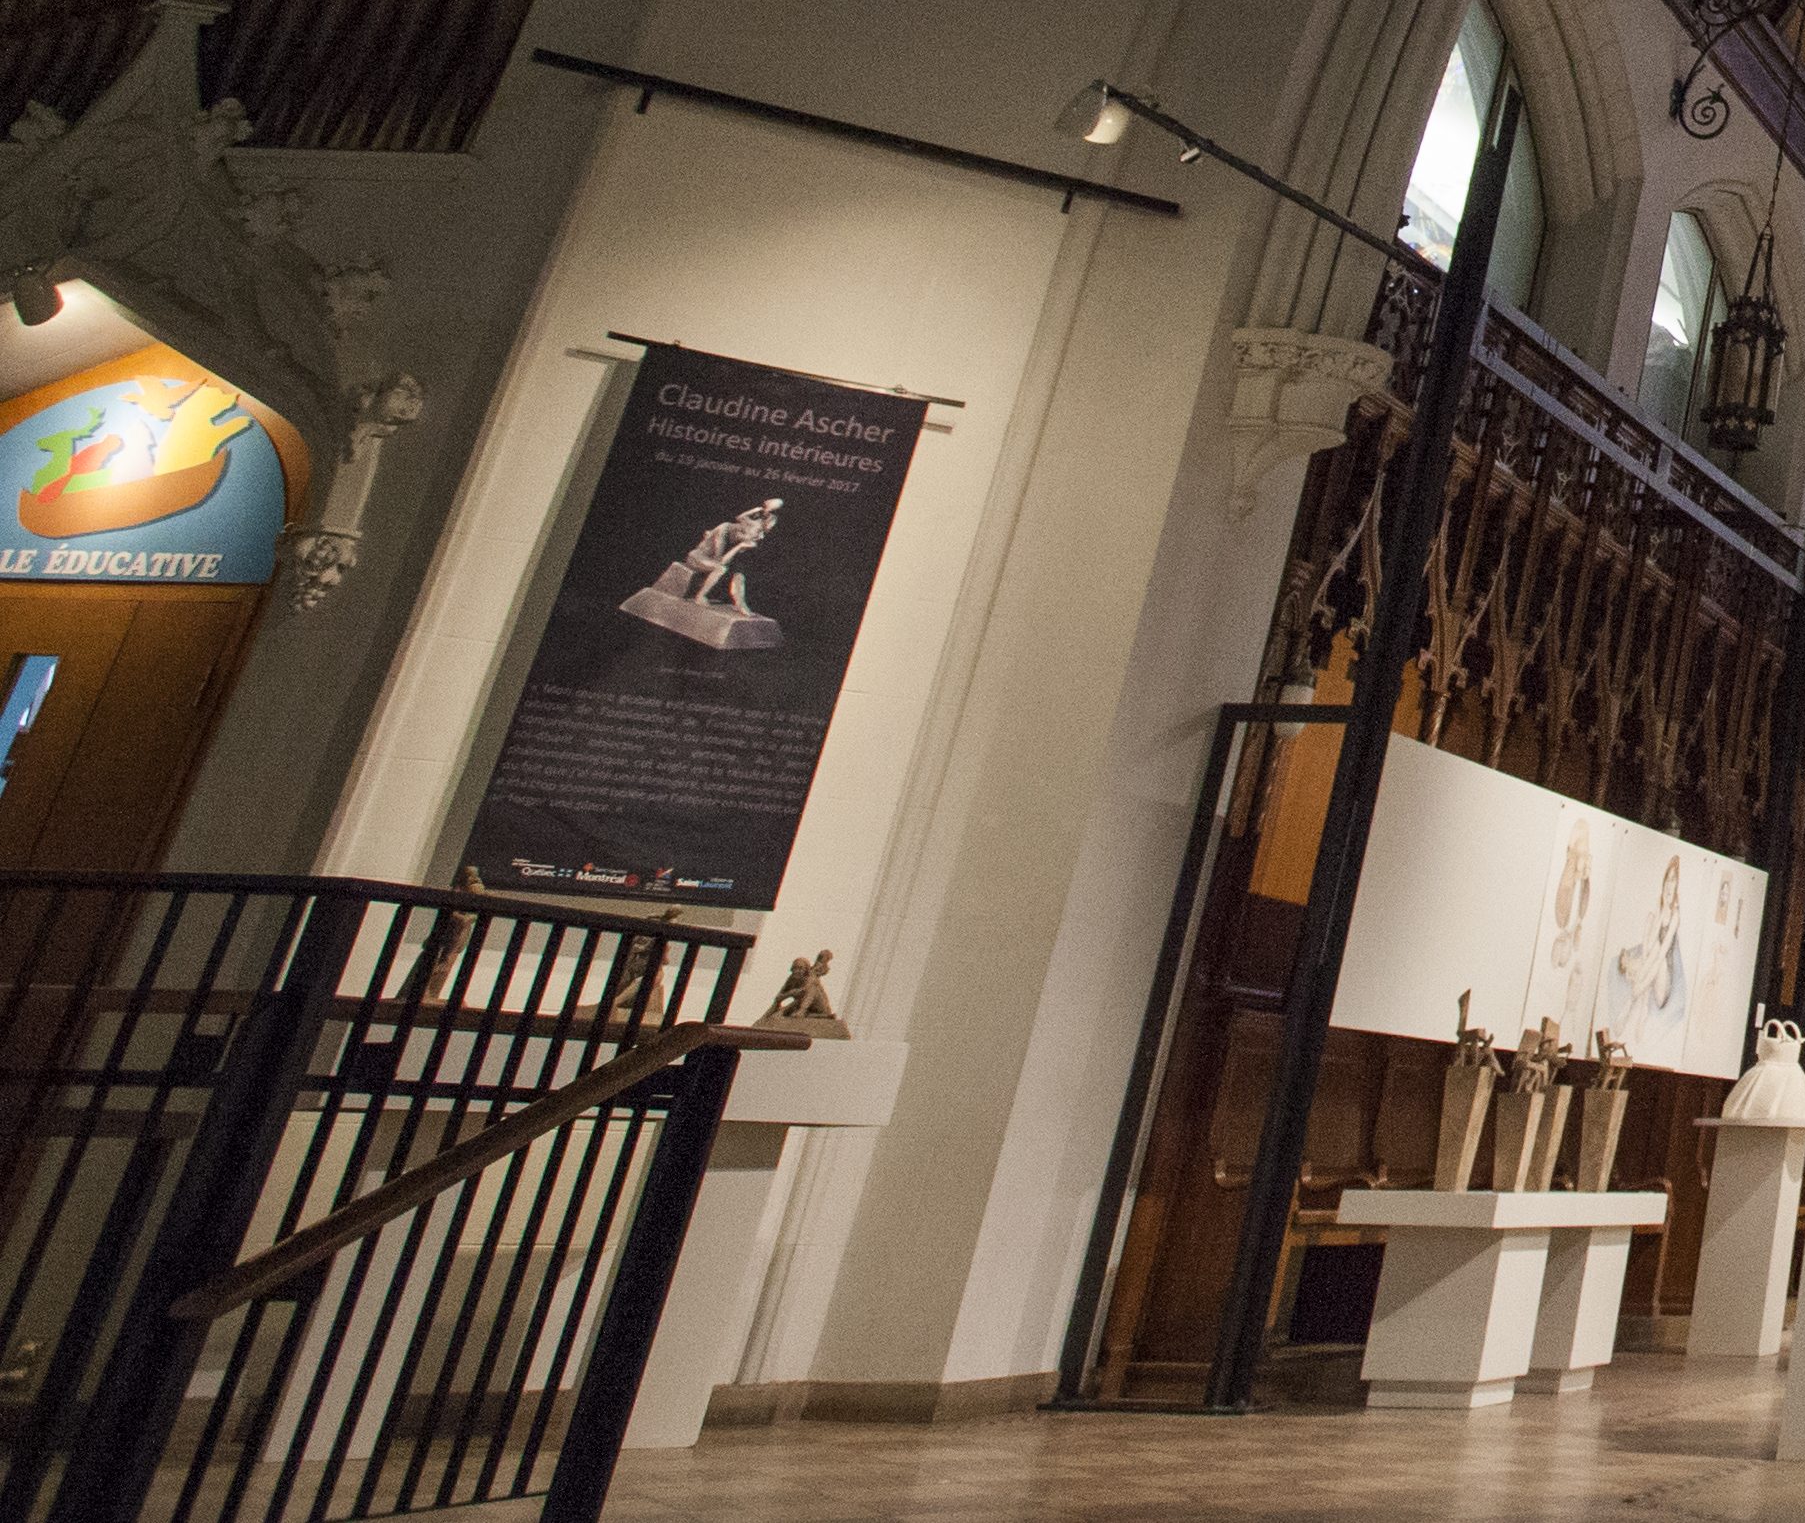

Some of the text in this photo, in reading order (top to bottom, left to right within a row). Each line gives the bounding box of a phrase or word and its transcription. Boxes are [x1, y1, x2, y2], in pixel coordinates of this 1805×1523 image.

[658, 382, 896, 445] Claudine Ascher
[647, 416, 884, 473] Histoires intérieures
[694, 457, 742, 475] janvier
[743, 467, 761, 477] au
[763, 467, 781, 481] 26
[782, 469, 826, 487] février
[827, 479, 861, 493] 2017
[43, 543, 224, 578] ÉDUCATIVE
[521, 866, 557, 878] Québec
[576, 870, 627, 884] Montréal
